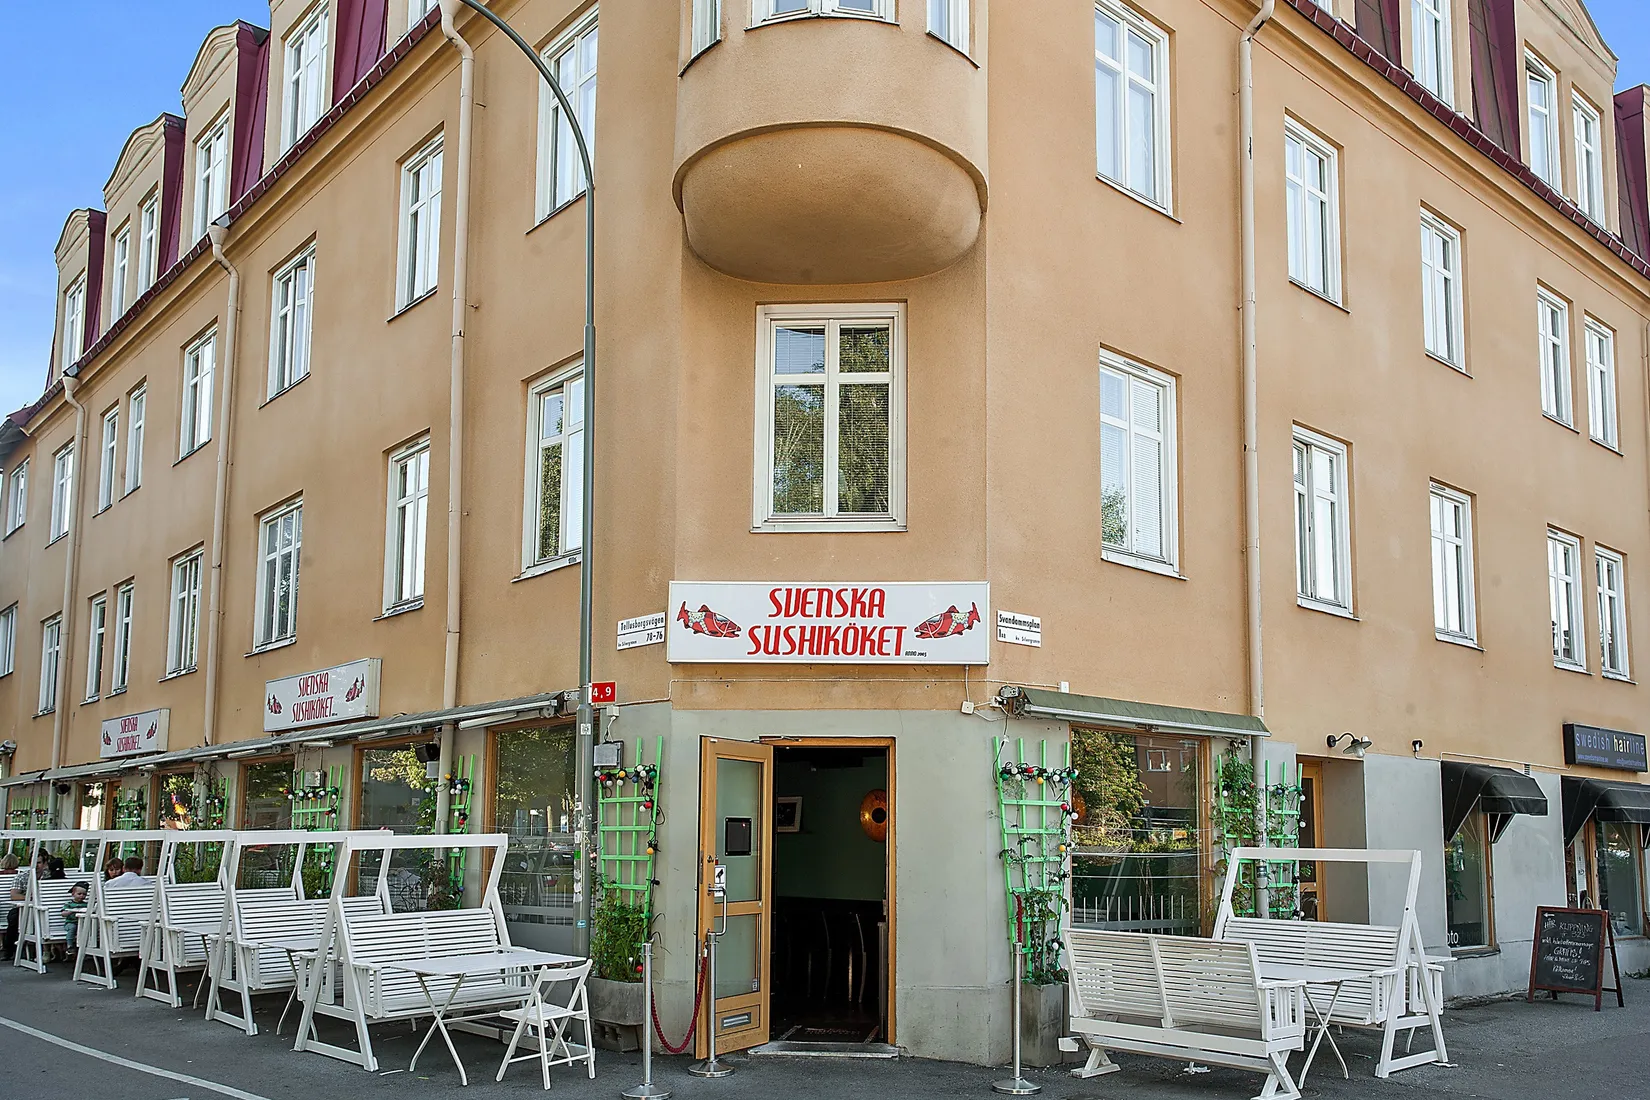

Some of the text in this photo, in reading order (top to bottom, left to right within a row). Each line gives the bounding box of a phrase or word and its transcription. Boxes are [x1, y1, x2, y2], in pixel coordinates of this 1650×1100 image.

[768, 588, 886, 618] SVENSKA
[620, 617, 664, 630] Tellusborgsvägen
[999, 613, 1040, 629] Svandammsplan
[646, 631, 663, 642] 78-76
[747, 622, 907, 657] SUSHIKÖKET
[297, 672, 329, 698] SVENSKA
[291, 696, 334, 723] SUSHIKÖKET
[1575, 733, 1645, 755] swedish hairline
